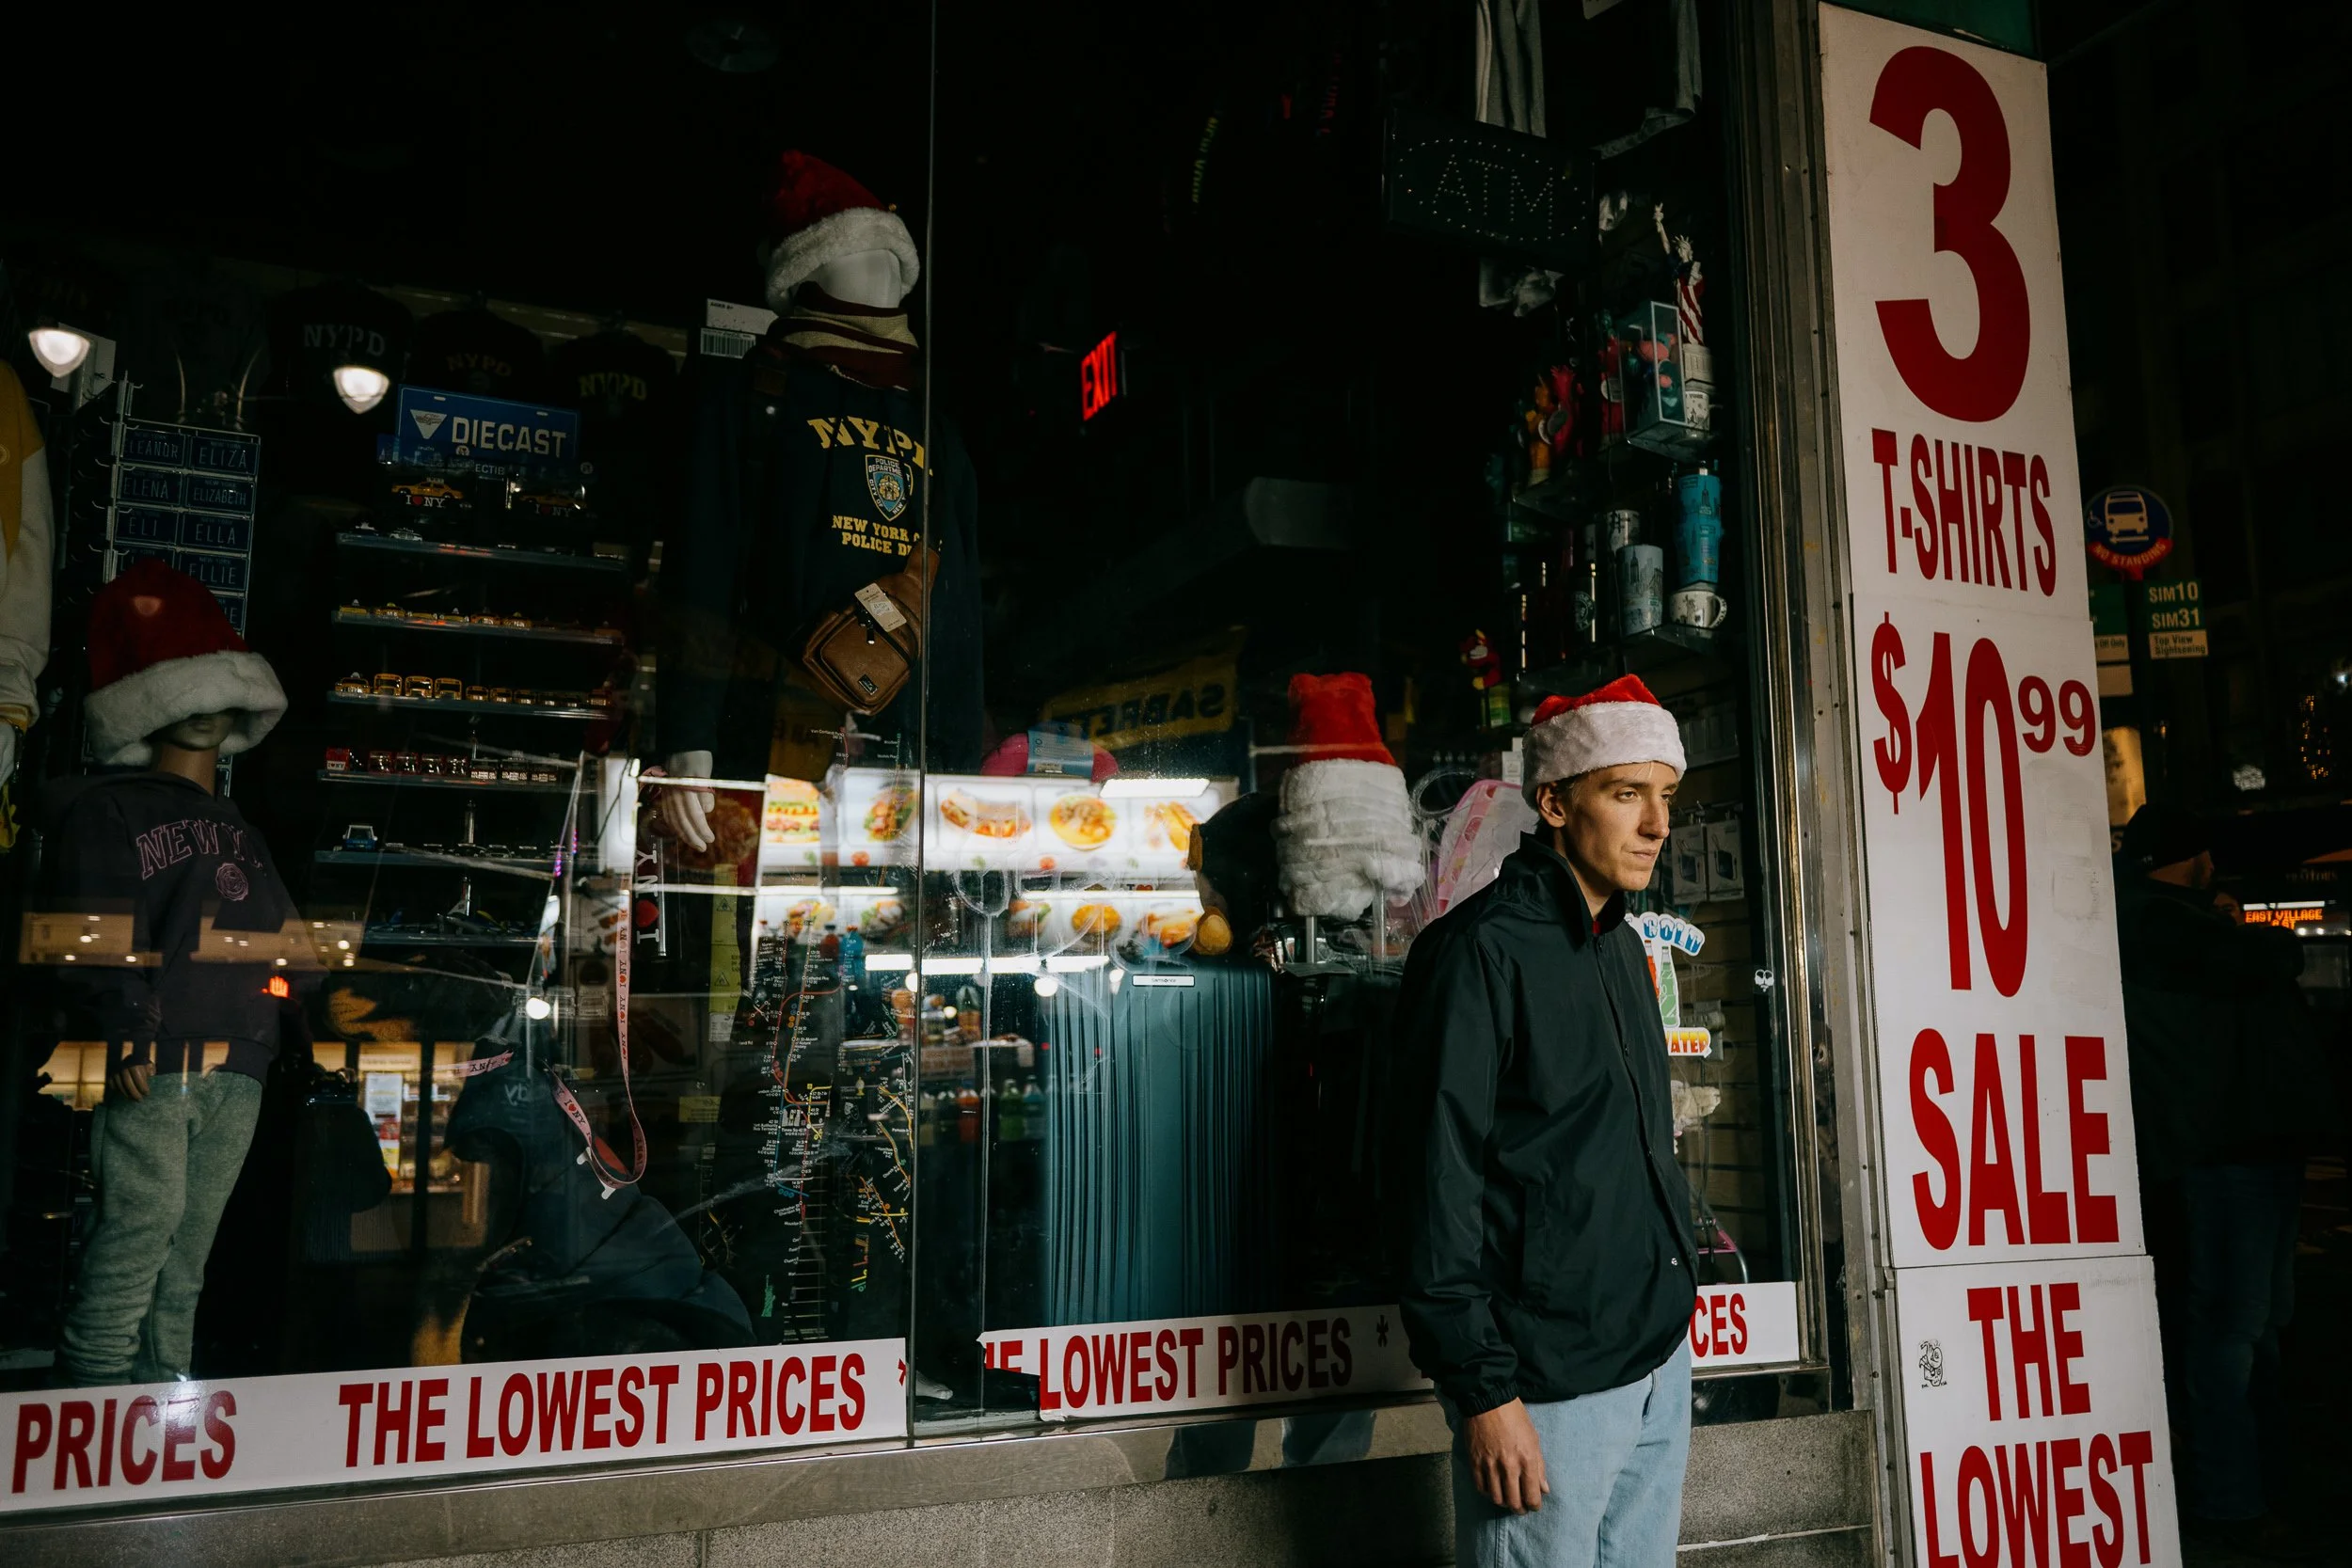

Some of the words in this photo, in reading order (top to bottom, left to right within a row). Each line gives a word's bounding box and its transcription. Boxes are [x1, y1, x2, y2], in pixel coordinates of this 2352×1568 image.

[1432, 153, 1555, 227] ATM
[1869, 46, 2030, 423] 3
[301, 323, 387, 357] NYPD
[445, 352, 513, 377] NYPD
[1080, 330, 1119, 422] EXIT
[123, 440, 179, 459] LEANOR
[451, 416, 567, 459] DIECAST
[199, 446, 248, 469] ELIZA
[875, 457, 900, 469] POLICE
[123, 477, 169, 499] ELENA
[193, 487, 247, 506] ELIZABETH
[405, 496, 412, 505] I
[423, 498, 446, 509] NY
[1871, 428, 2057, 597] T-SHIRTS
[128, 517, 158, 537] ELI
[195, 523, 236, 546] ELLA
[831, 515, 868, 531] NEW
[871, 521, 910, 541] YORK
[841, 531, 893, 555] POLICE
[2111, 541, 2168, 566] STANDING
[2149, 581, 2199, 604] SIM10
[2152, 607, 2201, 629] SIM31
[2153, 635, 2169, 645] Top
[2171, 635, 2193, 644] View
[2154, 645, 2206, 657] Sightseeing
[135, 818, 220, 880] NEW
[636, 850, 659, 898] NY
[2245, 910, 2273, 924] EAST
[2275, 909, 2323, 922] VILLAGE
[637, 928, 659, 944] I
[1644, 917, 1702, 953] COLD
[620, 960, 628, 975] NY
[1667, 1034, 1710, 1054] ATER
[573, 1112, 585, 1125] NY
[1909, 1027, 2121, 1251] SALE
[1692, 1291, 1750, 1356] CES
[1039, 1326, 1205, 1413] LOWEST
[1217, 1315, 1354, 1396] PRICES
[1967, 1282, 2091, 1421] THE
[338, 1377, 451, 1467] THE
[466, 1363, 680, 1459] LOWEST
[694, 1352, 867, 1442] PRICES
[12, 1388, 238, 1495] PRICES
[1919, 1431, 2154, 1568] LOWEST
